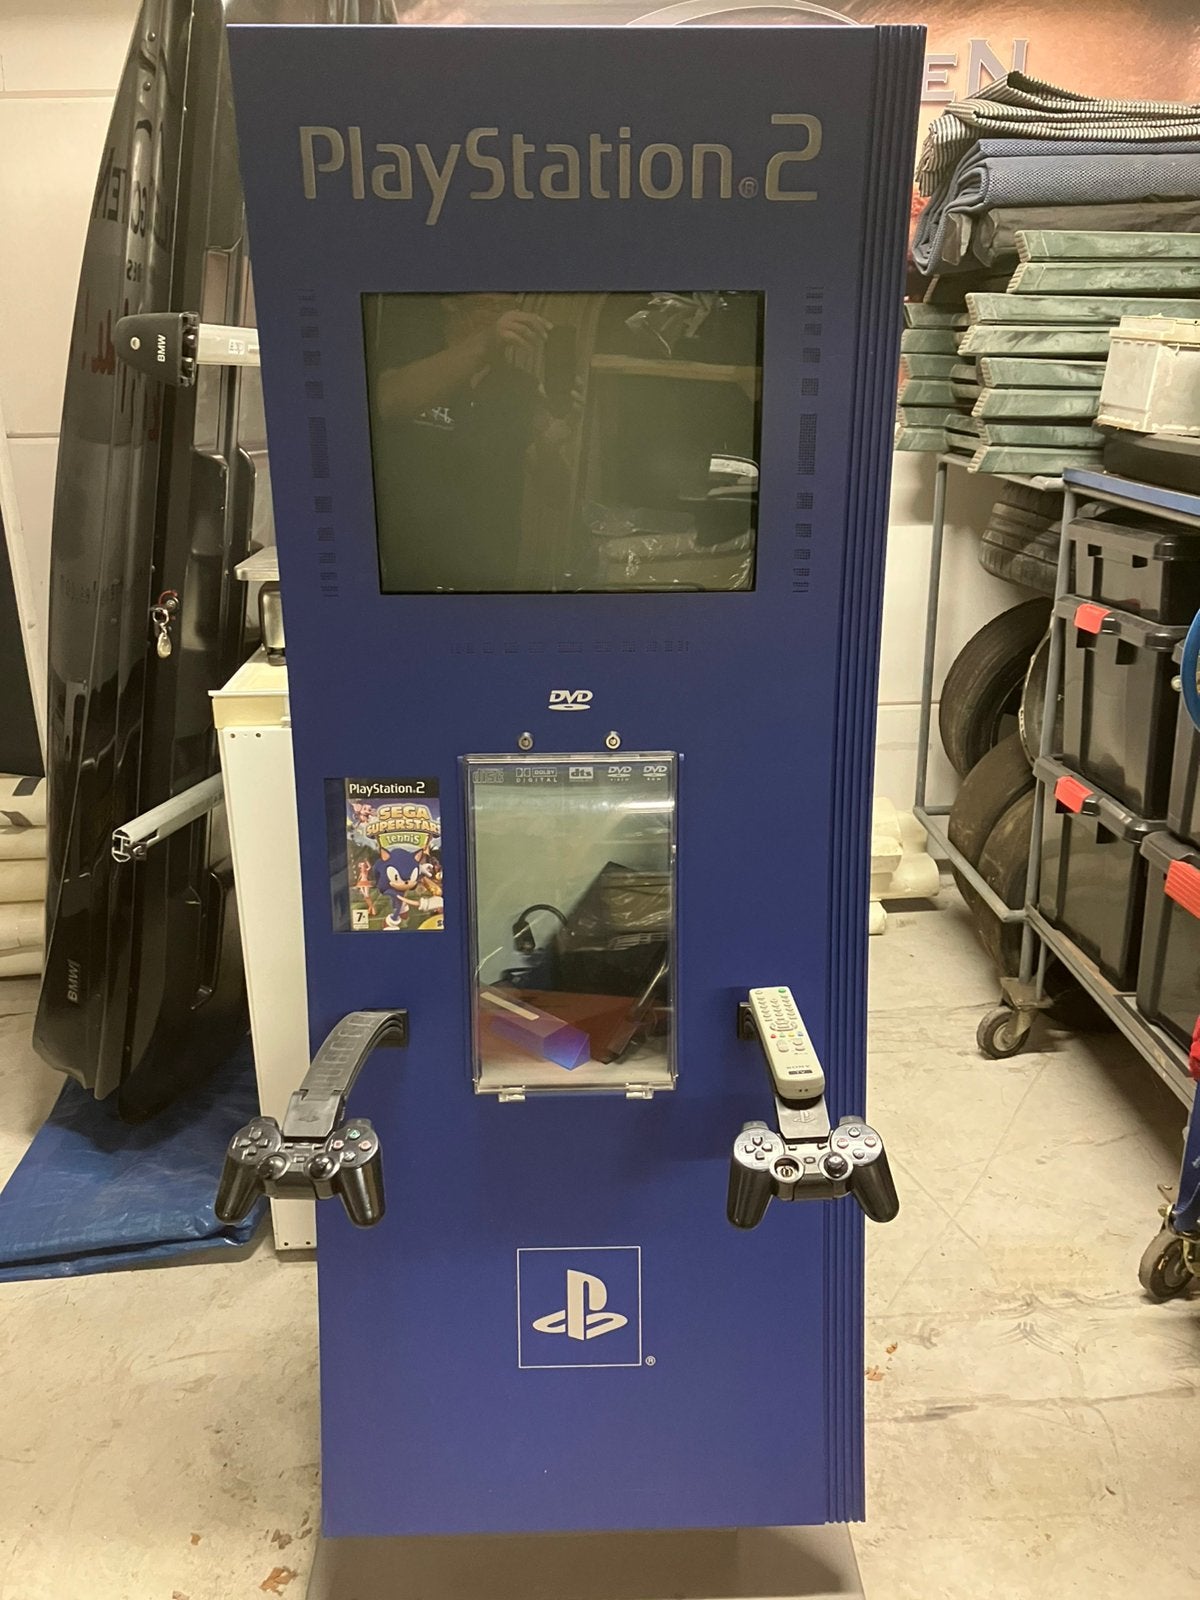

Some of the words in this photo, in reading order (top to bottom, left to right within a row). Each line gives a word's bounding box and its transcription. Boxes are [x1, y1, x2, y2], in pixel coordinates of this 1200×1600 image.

[156, 334, 166, 363] BMW
[549, 689, 594, 704] DVD
[570, 768, 593, 778] dts
[608, 766, 632, 774] DVD
[643, 765, 668, 774] DVD
[379, 805, 430, 820] SEGA
[386, 833, 420, 844] tennis
[67, 959, 80, 1004] BMW
